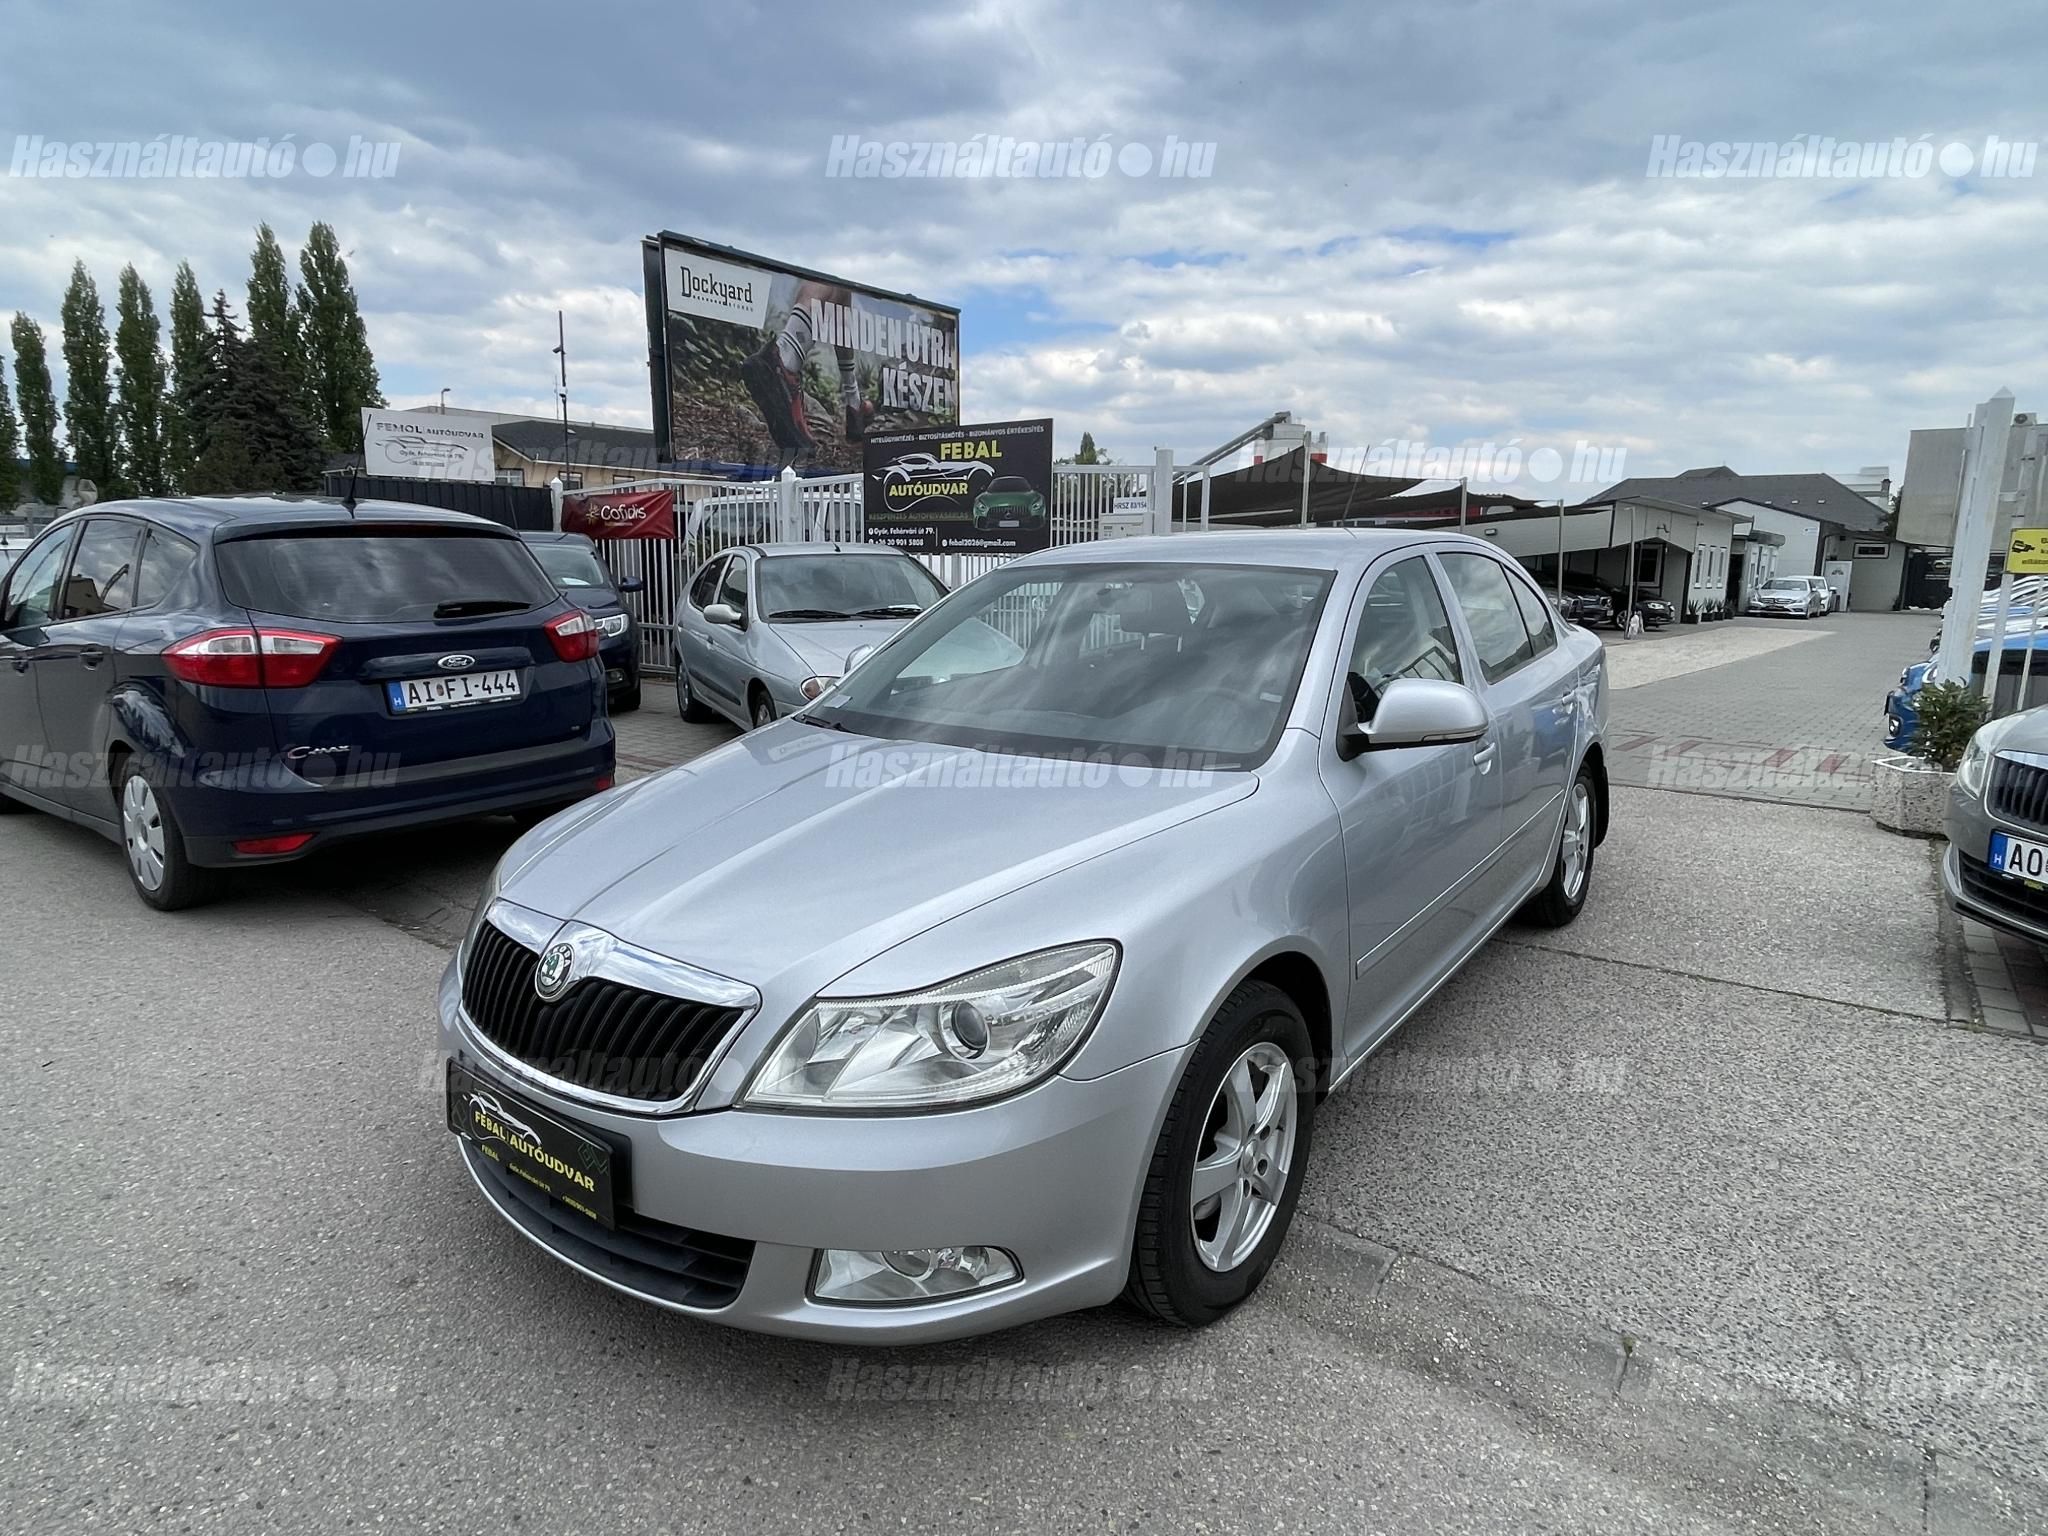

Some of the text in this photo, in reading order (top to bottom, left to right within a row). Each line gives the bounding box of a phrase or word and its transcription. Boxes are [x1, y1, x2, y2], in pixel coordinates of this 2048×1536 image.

[680, 266, 753, 306] Dockyard
[810, 298, 902, 360] MINDEN
[376, 422, 423, 435] FEMOL
[940, 439, 1003, 461] FEBAL
[888, 480, 969, 498] AUTÓUDVAR
[601, 503, 647, 520] Cofidis
[474, 1111, 506, 1141] FEBAL
[509, 1134, 595, 1192] AUTÓUDVAR
